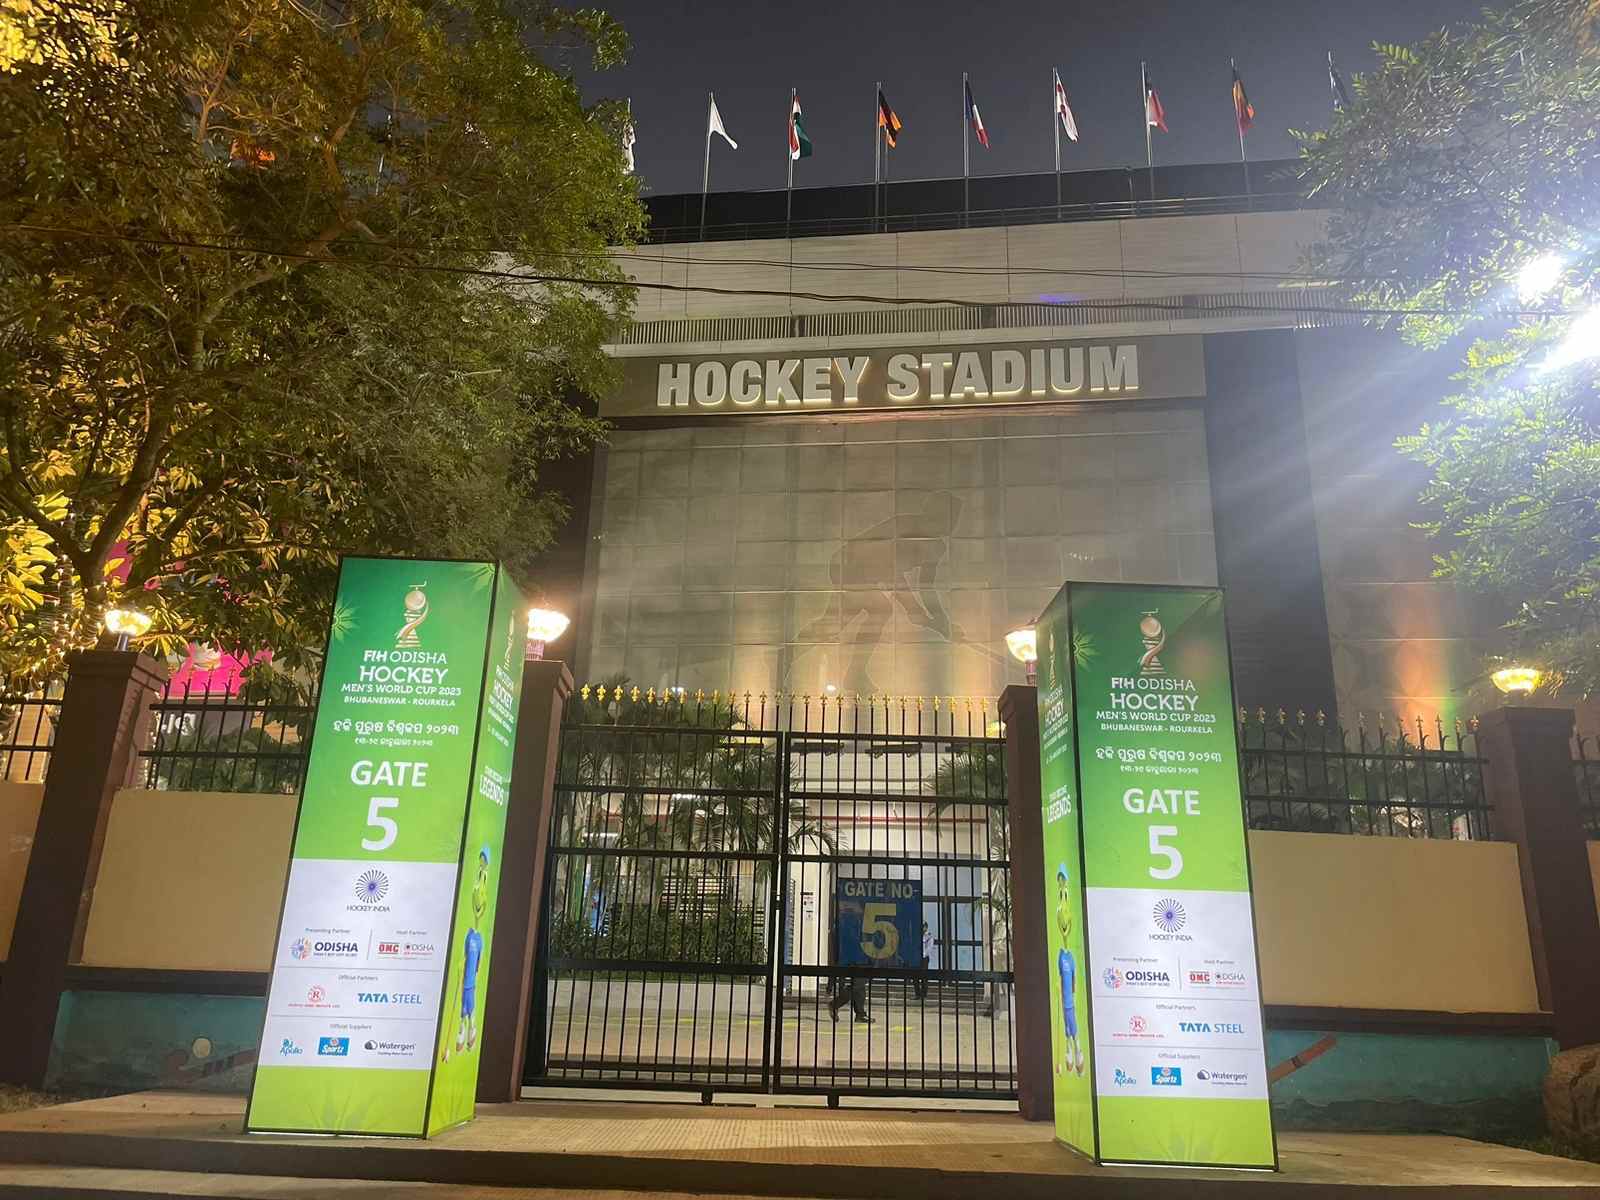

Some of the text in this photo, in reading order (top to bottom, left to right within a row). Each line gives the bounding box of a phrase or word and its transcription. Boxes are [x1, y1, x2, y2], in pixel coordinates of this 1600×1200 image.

[657, 344, 1139, 407] HOCKEY STADIUM
[364, 650, 448, 665] FIH ODISHA
[360, 666, 449, 684] HOCKEY
[341, 684, 462, 696] MEN'S WORLD CUP 2023
[1112, 678, 1196, 692] FIH ODISHA
[344, 696, 407, 705] BHUBANESWAR
[413, 698, 456, 706] ROURKELA
[1110, 693, 1199, 711] HOCKEY
[1096, 711, 1216, 723] MEN'S WORLD CUP 2023
[1100, 724, 1163, 732] BHUBANESWAR
[1170, 725, 1212, 734] ROURKELA
[350, 760, 429, 787] GATE
[1122, 788, 1201, 816] GATE
[361, 797, 400, 851] 5
[1148, 825, 1184, 880] 5
[845, 882, 885, 897] GATE
[860, 902, 899, 960] 5
[314, 942, 359, 953] ODISHA
[1125, 971, 1170, 982] ODISHA
[358, 993, 422, 1005] TATA STEEL
[1179, 1022, 1245, 1033] TATA STEEL
[280, 1046, 303, 1057] Apollo
[378, 1042, 416, 1052] Watergen
[1211, 1072, 1248, 1081] Watergen
